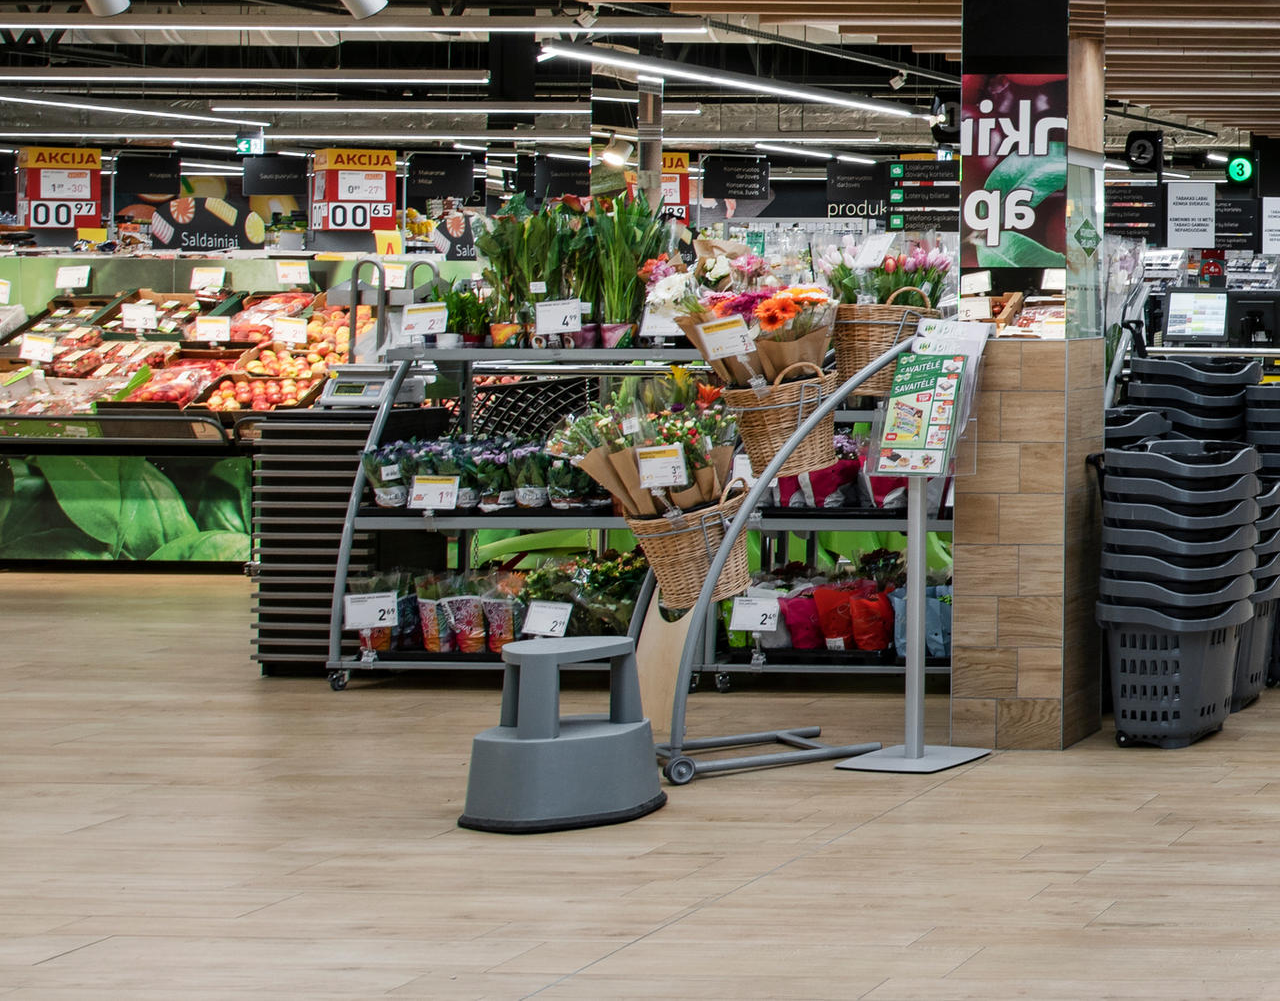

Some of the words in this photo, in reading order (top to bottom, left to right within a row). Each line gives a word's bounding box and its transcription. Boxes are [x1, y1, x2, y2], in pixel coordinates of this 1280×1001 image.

[35, 152, 97, 165] AKCIJA
[334, 153, 393, 167] AKCIJA
[1235, 163, 1245, 177] 3
[33, 202, 72, 226] 00
[75, 202, 95, 214] 97
[331, 204, 367, 227] 00
[372, 204, 391, 216] 65
[827, 199, 888, 219] produk
[181, 231, 239, 248] Saldainiai
[894, 377, 936, 395] SAVAITĖLĖ
